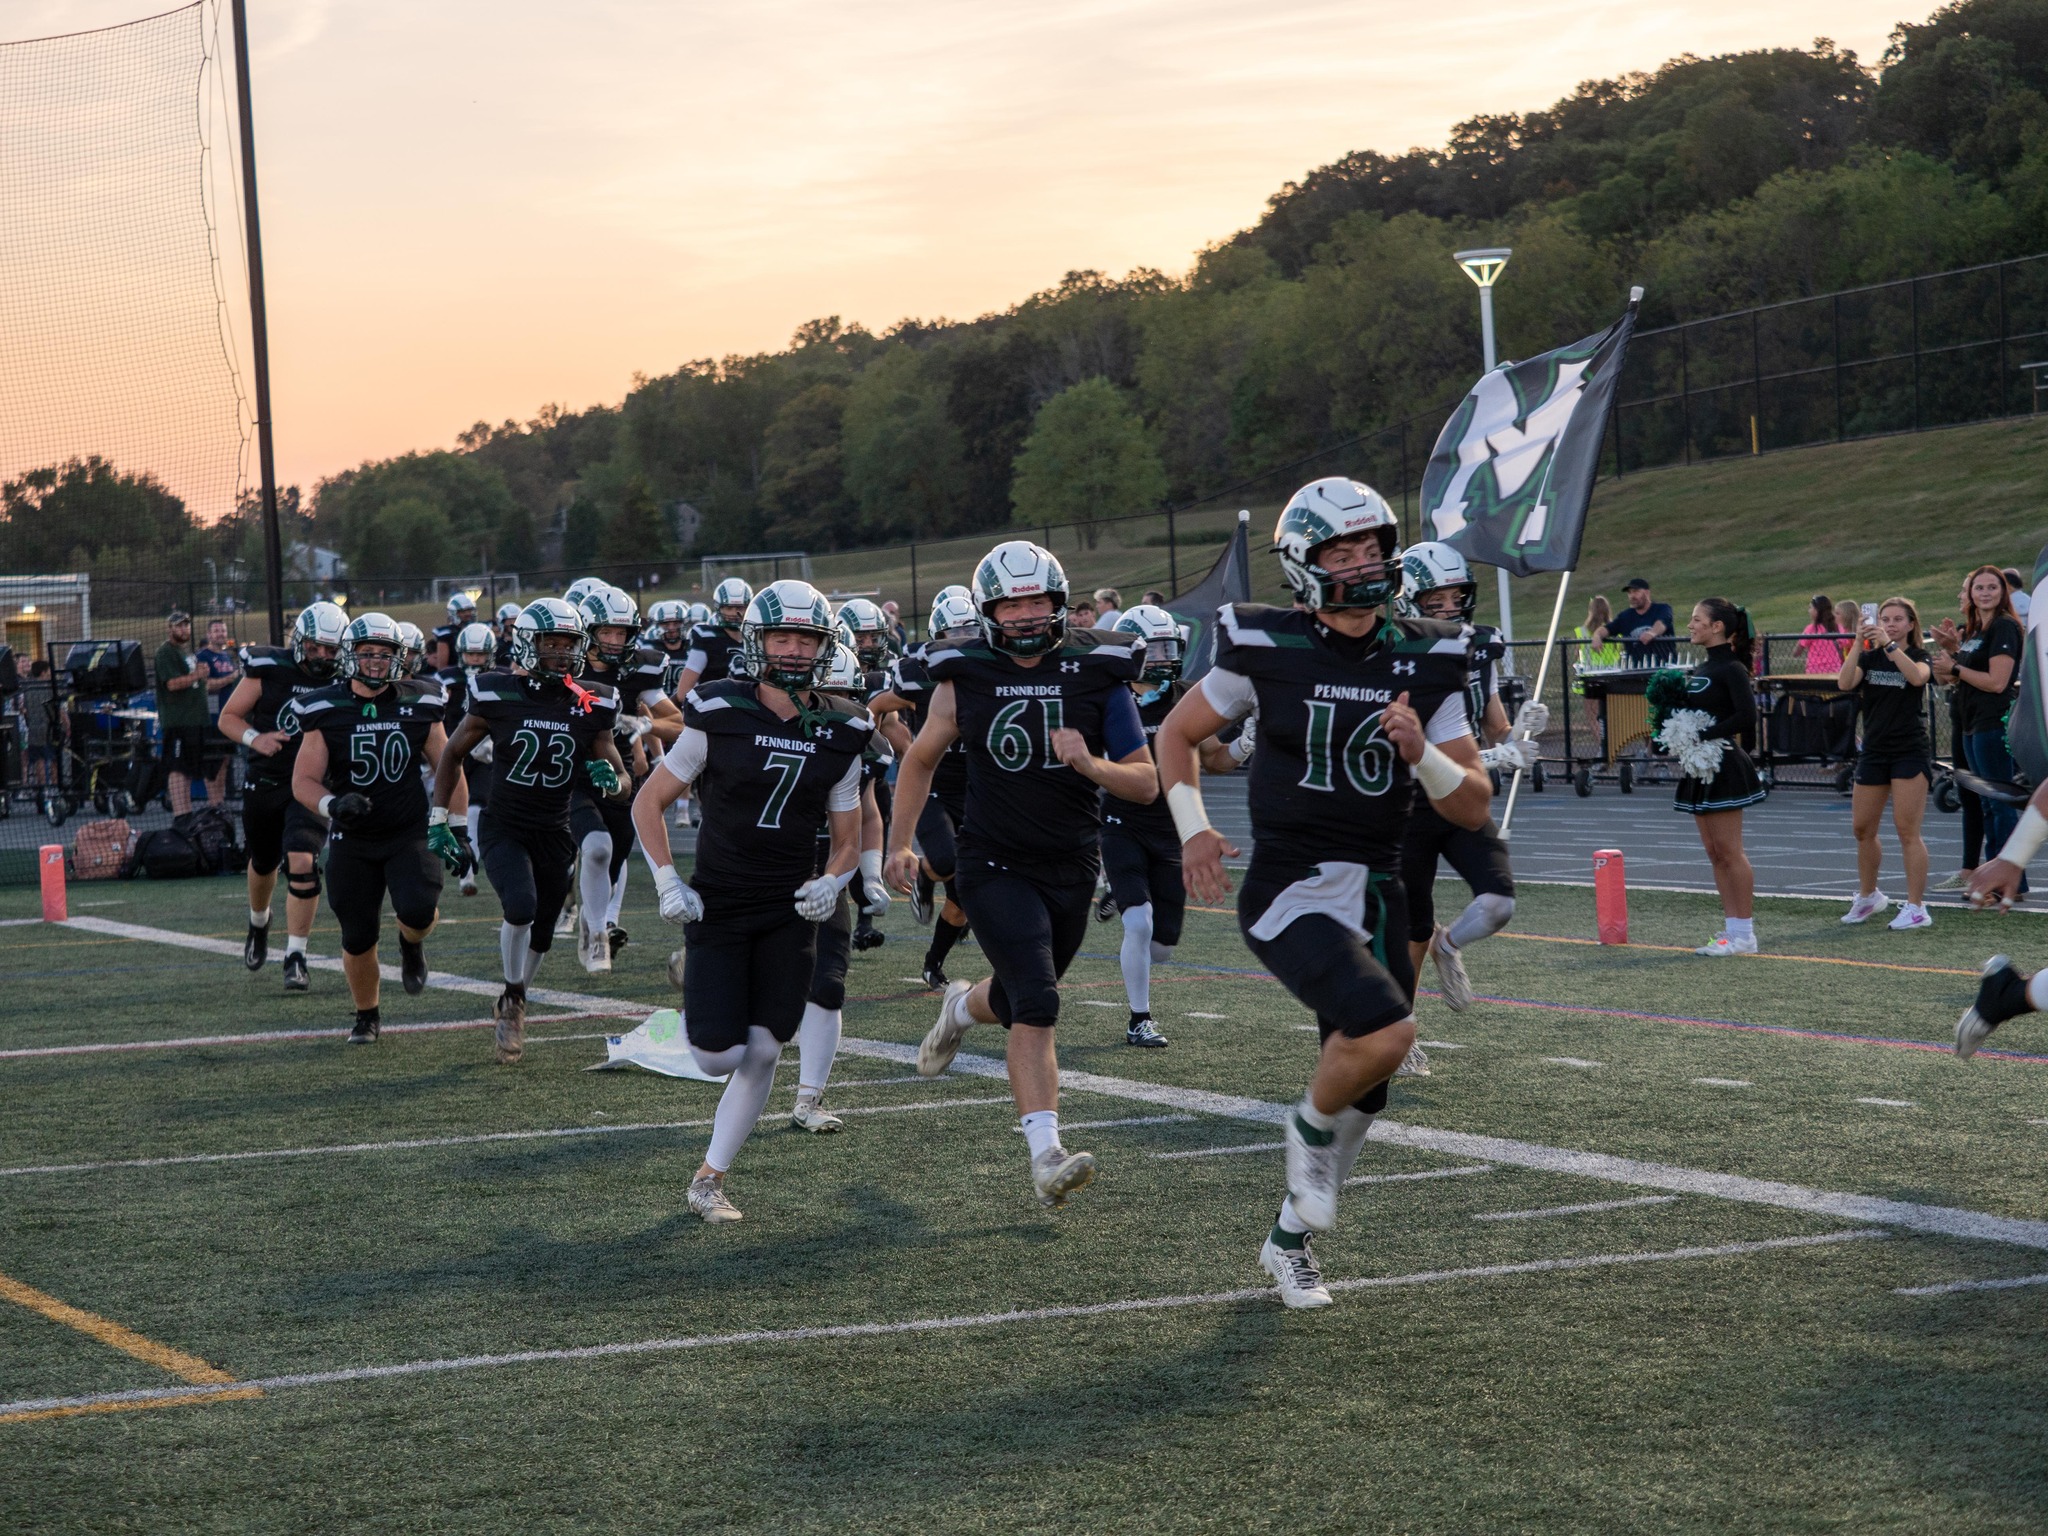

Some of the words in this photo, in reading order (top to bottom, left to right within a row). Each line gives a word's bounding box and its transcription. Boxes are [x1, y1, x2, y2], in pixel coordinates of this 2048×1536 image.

[1344, 514, 1377, 527] Riddell
[1011, 584, 1041, 594] Riddell
[995, 685, 1063, 697] PENNRIDGE
[1314, 684, 1392, 702] PENNRIDGE
[356, 722, 401, 733] PENNRIDGE
[523, 719, 571, 732] PENNRIDGE
[754, 735, 817, 754] PENNRIDGE
[987, 699, 1069, 772] 61
[1297, 699, 1396, 797] 16
[350, 730, 411, 786] 50
[506, 729, 576, 788] 23
[756, 751, 807, 829] 7
